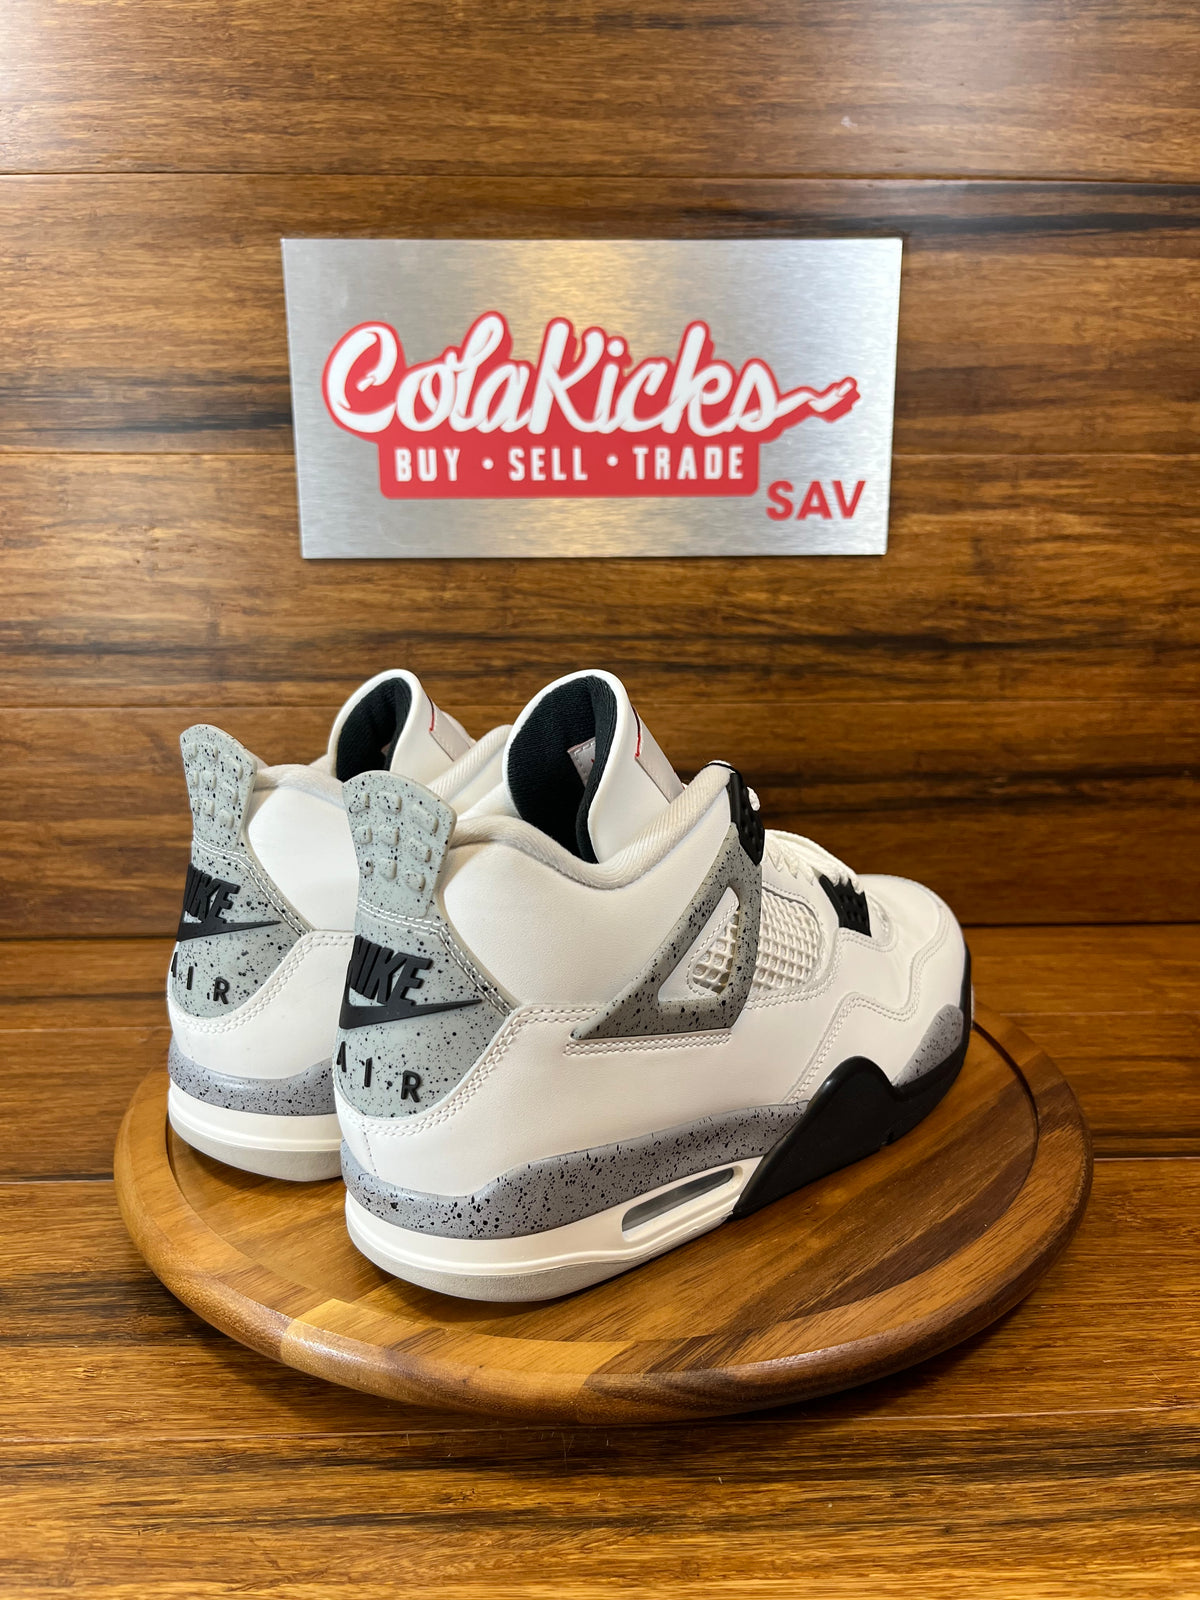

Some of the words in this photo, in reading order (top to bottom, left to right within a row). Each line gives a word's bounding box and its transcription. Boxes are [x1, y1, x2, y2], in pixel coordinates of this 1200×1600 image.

[395, 448, 462, 482] BUY
[508, 448, 589, 482] SELL
[633, 446, 745, 480] TRADE
[766, 480, 866, 521] SAV
